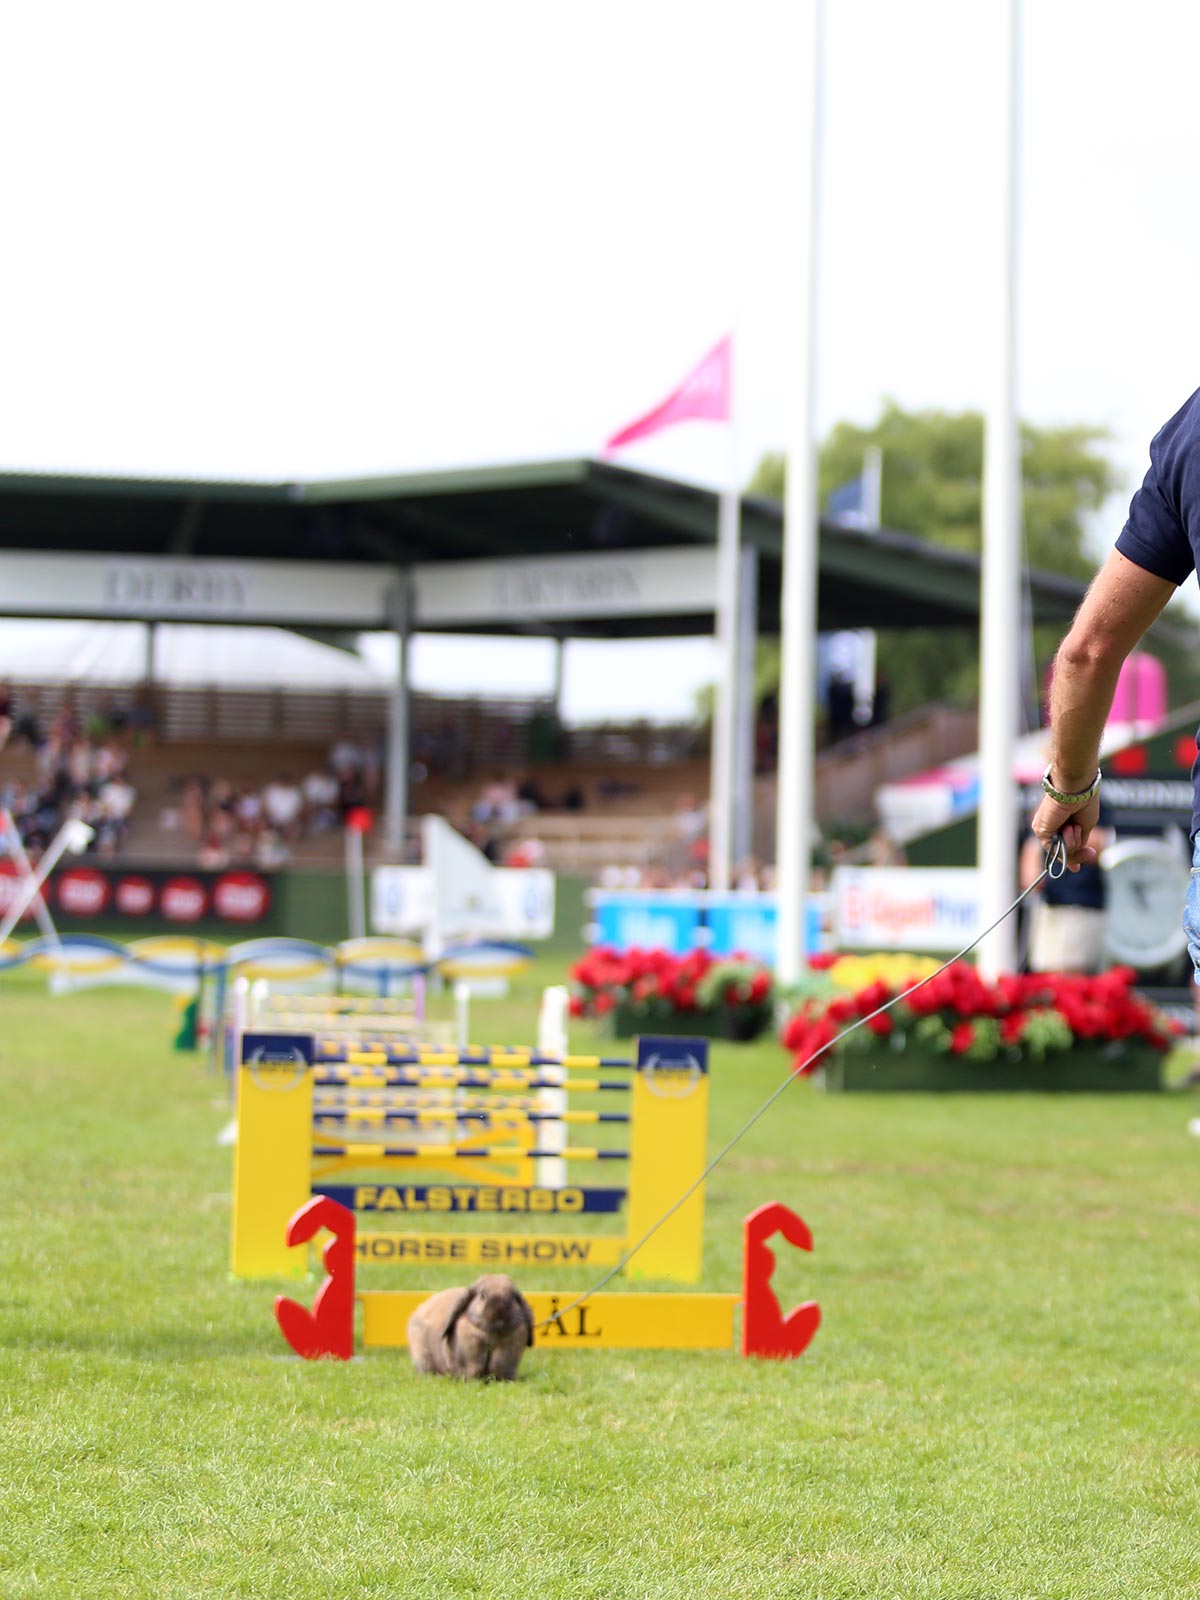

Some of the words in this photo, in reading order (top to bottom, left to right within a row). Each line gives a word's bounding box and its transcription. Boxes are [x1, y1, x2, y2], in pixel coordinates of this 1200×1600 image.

[355, 1185, 585, 1212] FALSTERBO
[480, 1239, 591, 1260] SHOW
[541, 1296, 603, 1336] ÅL
